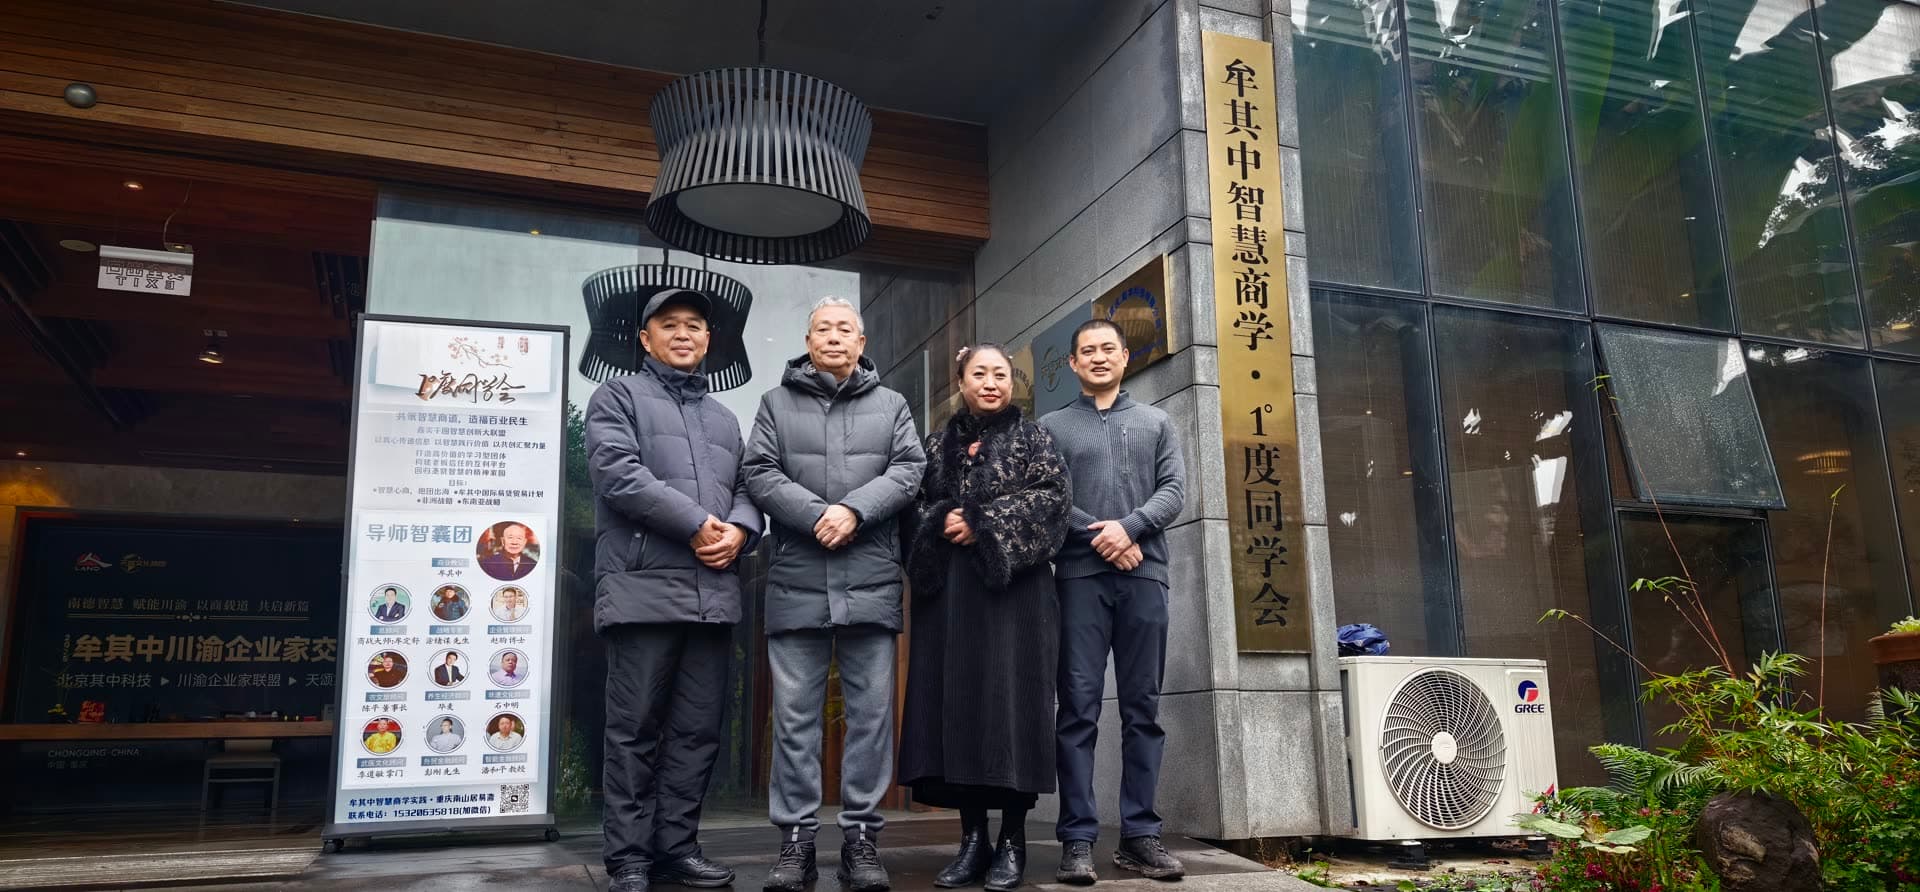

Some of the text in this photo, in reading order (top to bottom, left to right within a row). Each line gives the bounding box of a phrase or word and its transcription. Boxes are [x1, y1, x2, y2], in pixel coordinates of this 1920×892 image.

[366, 523, 472, 544] 导师智囊团
[72, 633, 337, 664] 牟其中川渝企业家交
[57, 672, 337, 688] 北京其中科技 川渝企业家联盟 天颂
[1515, 704, 1545, 713] GREE
